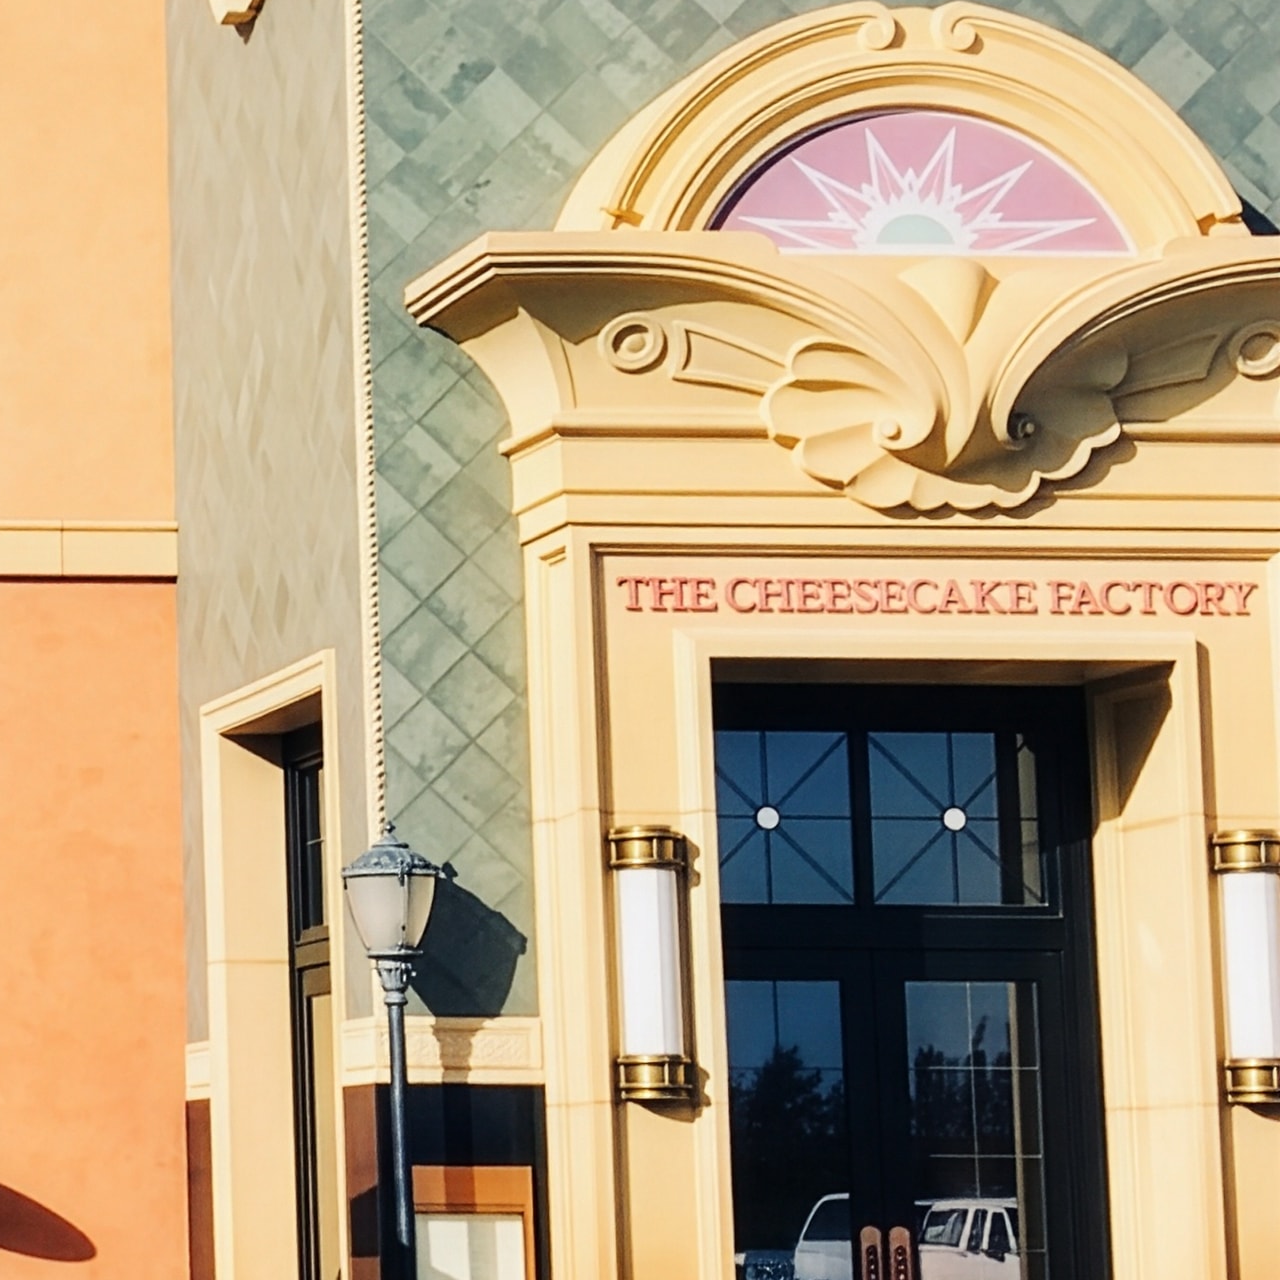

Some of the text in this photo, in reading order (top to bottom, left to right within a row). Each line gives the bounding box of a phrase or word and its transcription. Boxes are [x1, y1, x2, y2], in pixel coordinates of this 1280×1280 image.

[616, 576, 1259, 617] THE CHEESECAKE FACTORY
